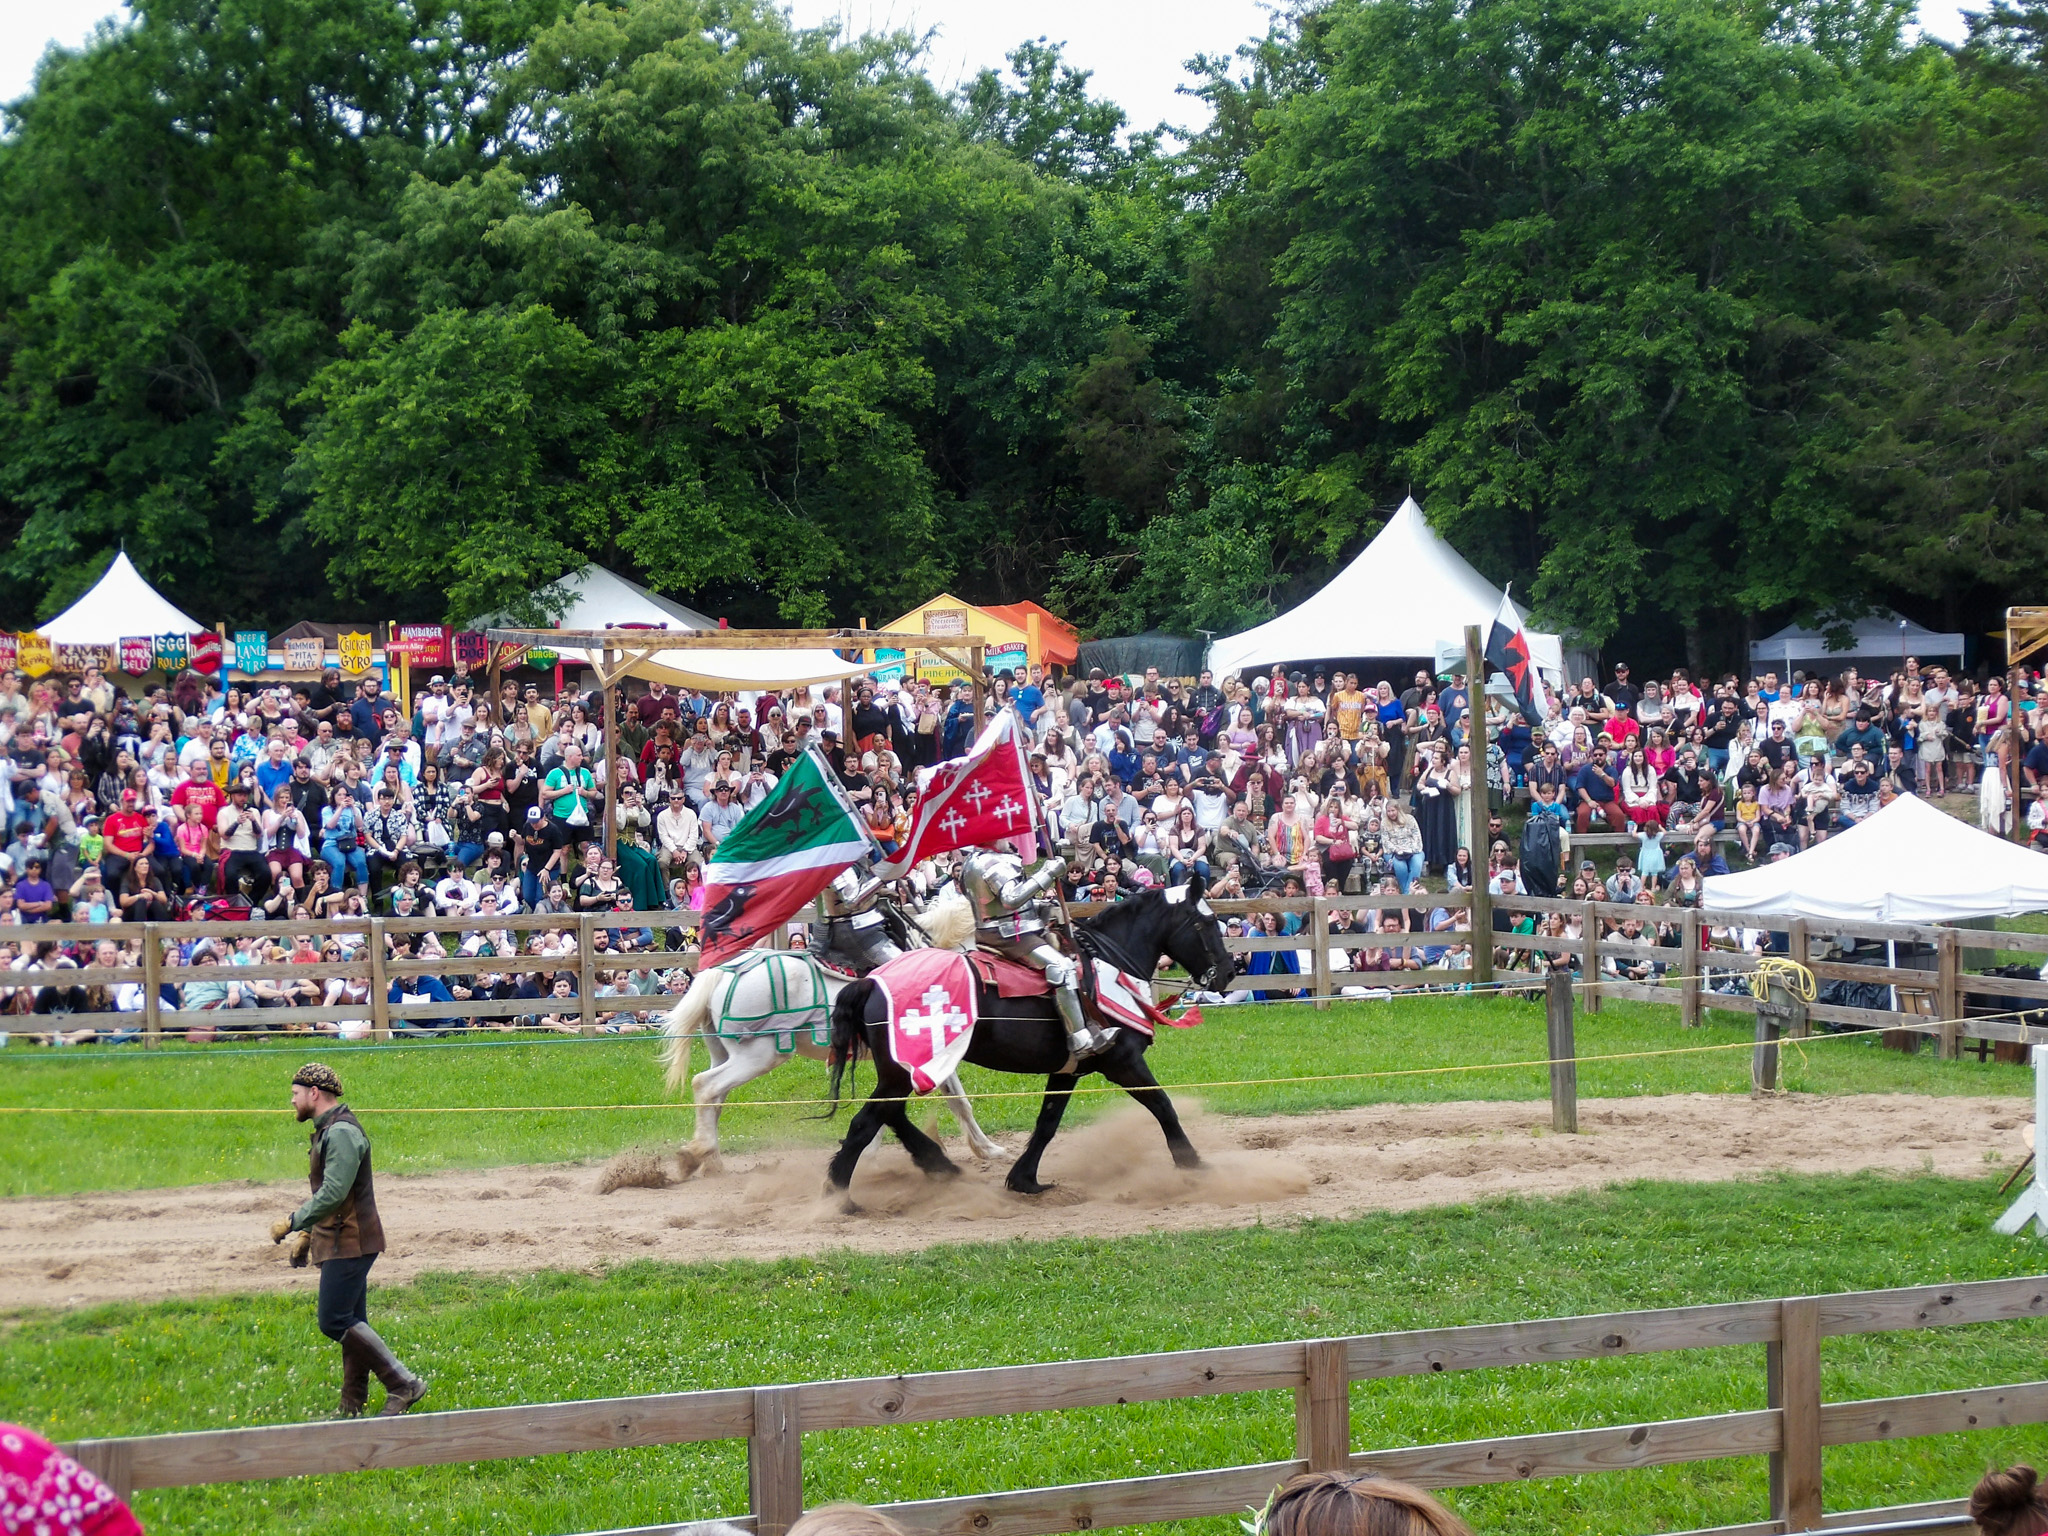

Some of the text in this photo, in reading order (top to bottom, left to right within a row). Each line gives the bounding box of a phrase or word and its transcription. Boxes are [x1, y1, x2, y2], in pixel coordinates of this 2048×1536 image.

[156, 637, 186, 652] EGG
[236, 634, 256, 643] BEEF
[459, 635, 485, 647] HOT
[59, 644, 111, 658] RAMEN
[288, 641, 316, 650] HUMMUS
[410, 643, 424, 651] Alley
[985, 647, 1002, 656] MILK
[121, 648, 153, 660] PORK
[237, 645, 267, 660] LAMB
[460, 647, 485, 659] DOG
[528, 649, 559, 659] BURGER
[61, 657, 107, 670] HOD
[122, 659, 151, 671] BELLY
[157, 656, 187, 671] ROLLS
[237, 660, 267, 673] GYRO
[292, 661, 316, 669] PLATE
[341, 655, 371, 670] GYRO
